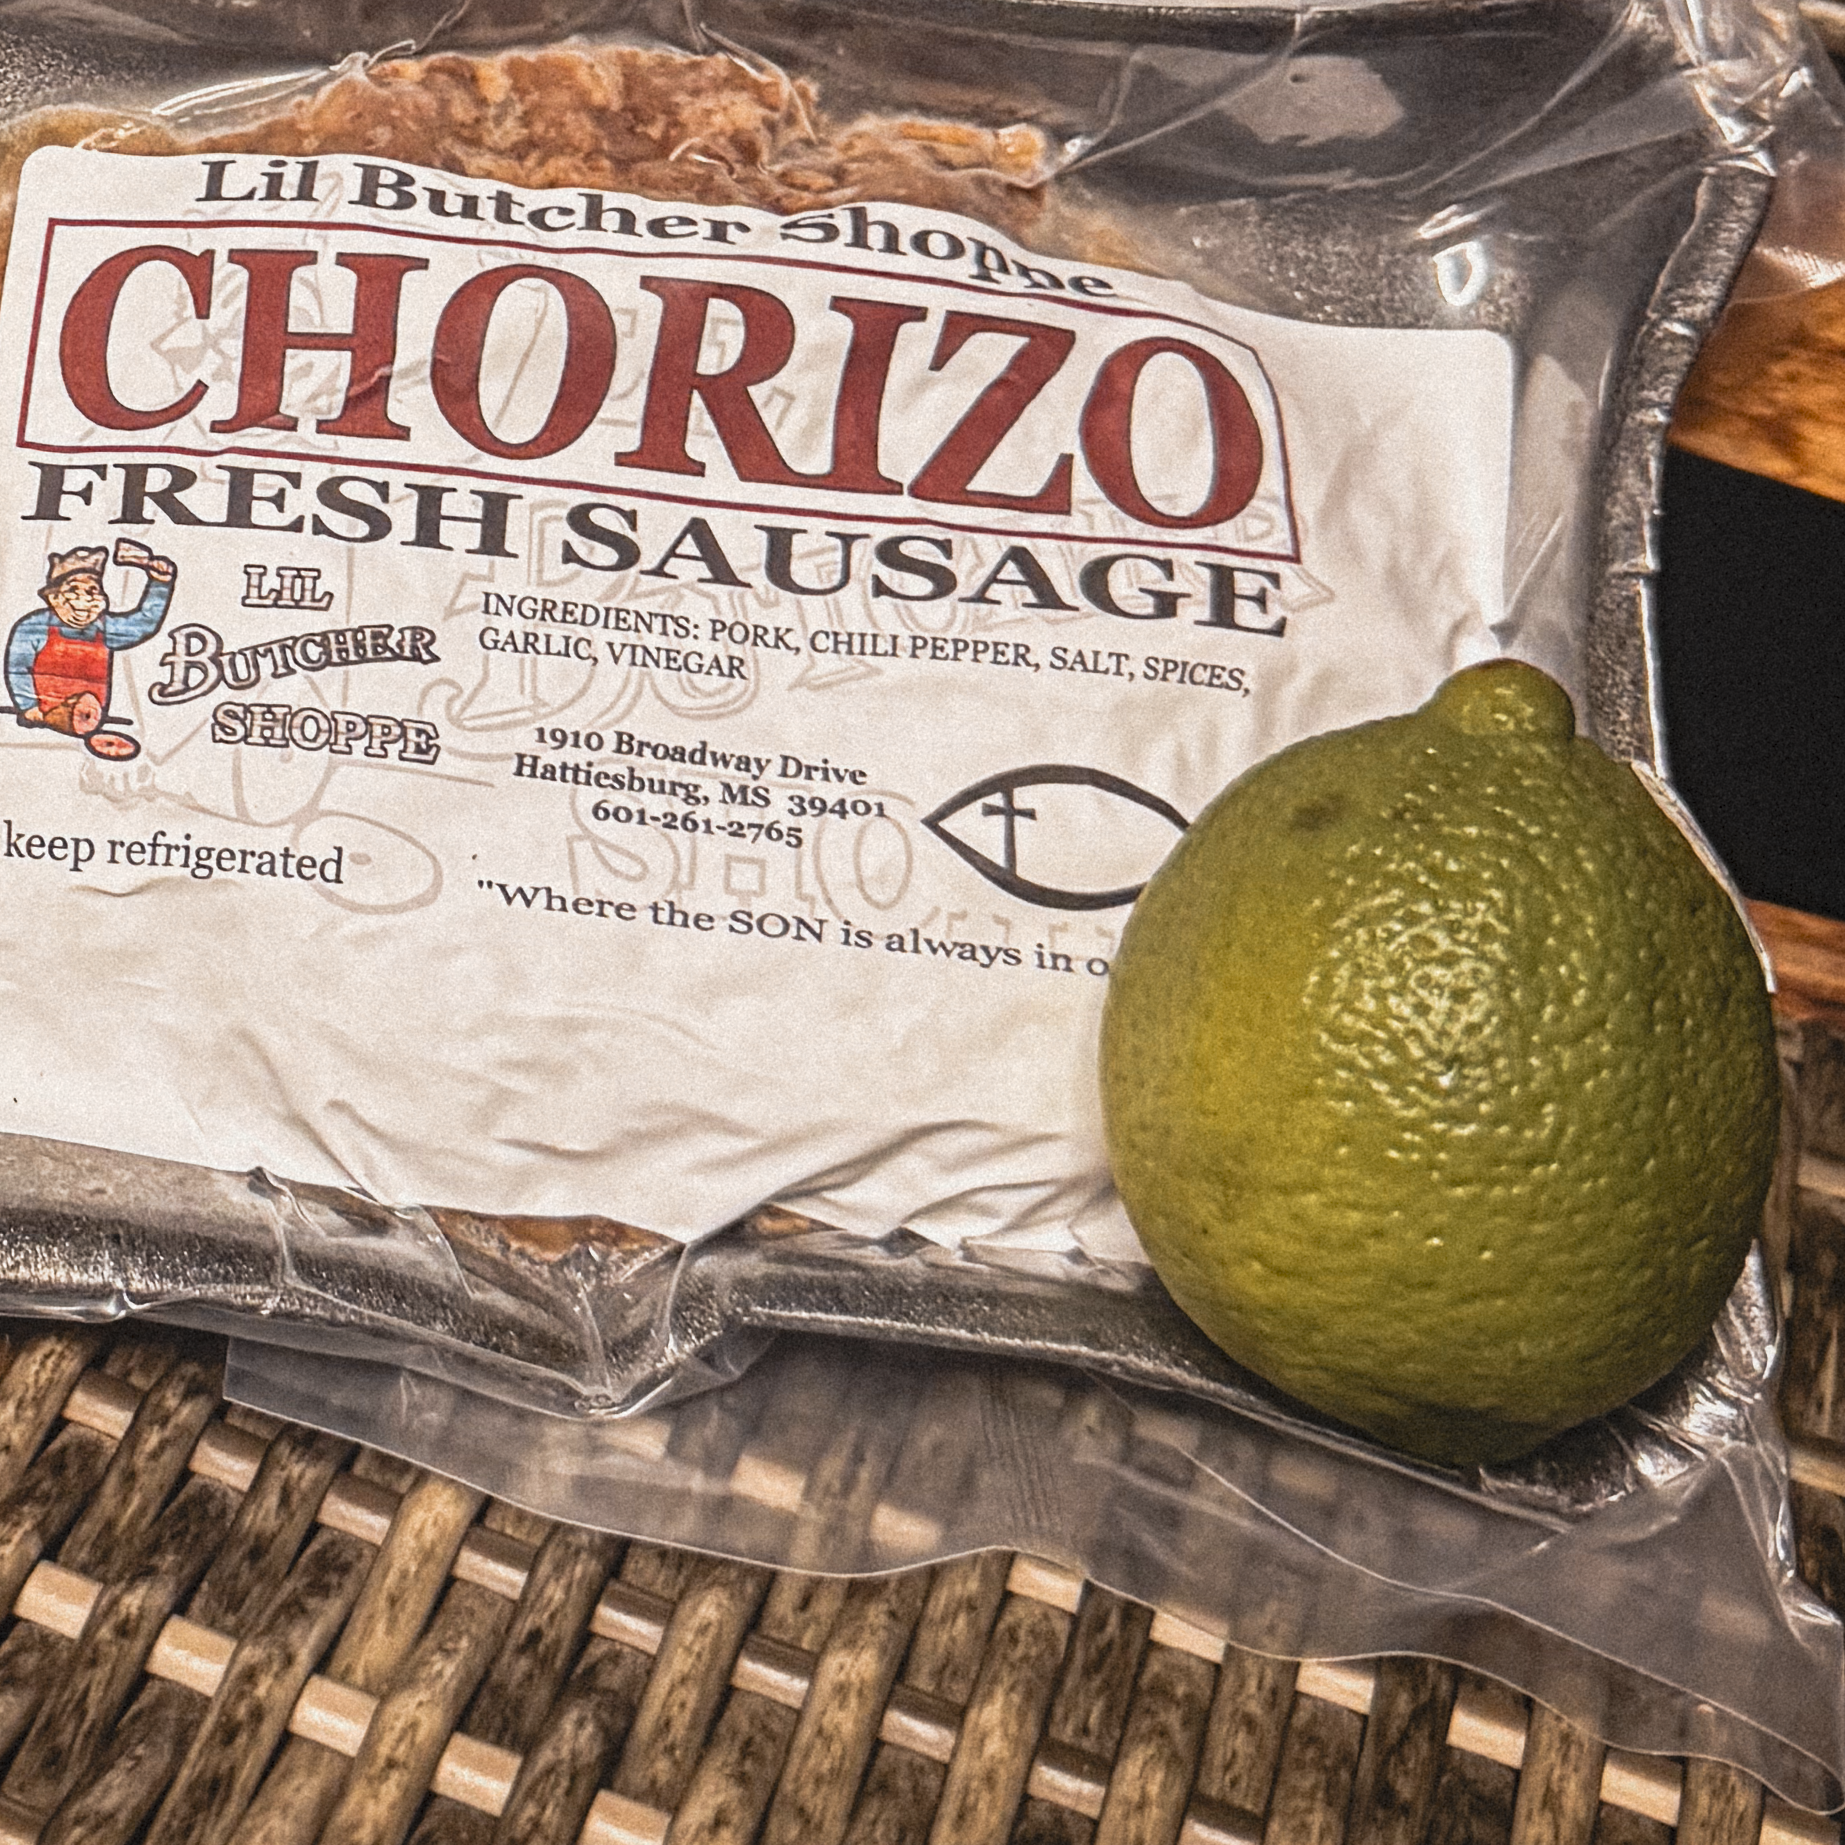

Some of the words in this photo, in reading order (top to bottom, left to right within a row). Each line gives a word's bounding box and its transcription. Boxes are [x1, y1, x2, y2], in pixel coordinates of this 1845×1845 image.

[194, 158, 321, 204] Lil
[348, 162, 751, 246] Butcher
[59, 246, 1263, 529] CHORIZO
[21, 462, 523, 558] FRESH
[561, 498, 1288, 638] SAUSAGE
[241, 564, 334, 610] LIL
[478, 627, 598, 666] GARLIC,
[606, 641, 749, 681] VINEGAR
[482, 591, 700, 641] INGREDIENTS:
[709, 618, 802, 656] PORK,
[809, 629, 900, 658] CHILI
[910, 635, 1041, 672] PEPPER,
[1049, 646, 1136, 682] SALT,
[1142, 656, 1252, 697] SPICES,
[211, 703, 442, 765] SHOPPE
[534, 726, 604, 753] 1910
[614, 730, 771, 780] Broadway
[778, 755, 868, 786] Drive
[513, 753, 710, 806] Hattiesburg,
[719, 781, 772, 809] MS
[787, 794, 887, 820] 39401
[3, 820, 96, 864] keep
[107, 831, 344, 884] refrigerated
[591, 800, 804, 849] 601-261-2765
[477, 880, 637, 923] "Where
[651, 900, 716, 933] the
[728, 909, 827, 945] SON
[841, 921, 873, 949] is
[885, 928, 1022, 969] always
[1035, 943, 1074, 973] in
